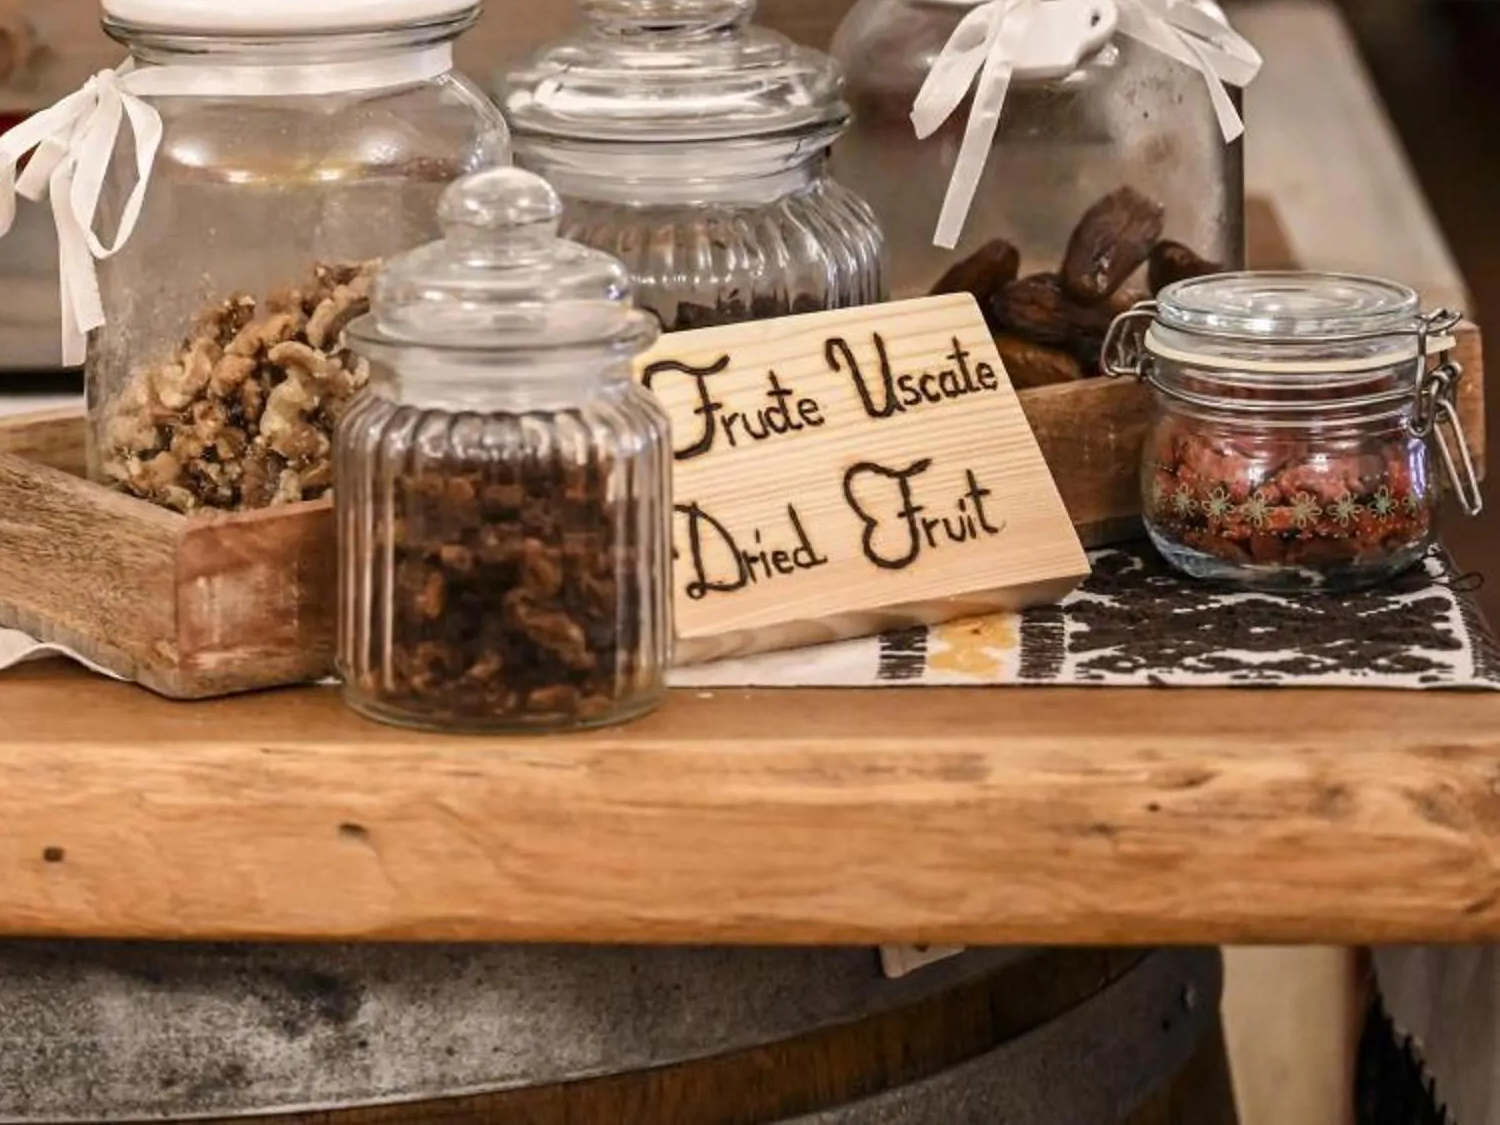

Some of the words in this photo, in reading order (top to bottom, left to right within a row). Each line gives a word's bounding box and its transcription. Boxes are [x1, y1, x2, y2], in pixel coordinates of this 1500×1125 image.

[641, 354, 825, 459] Fructe
[825, 331, 999, 419] Uscate
[673, 501, 827, 600] Dried
[843, 457, 1002, 569] Fruit
